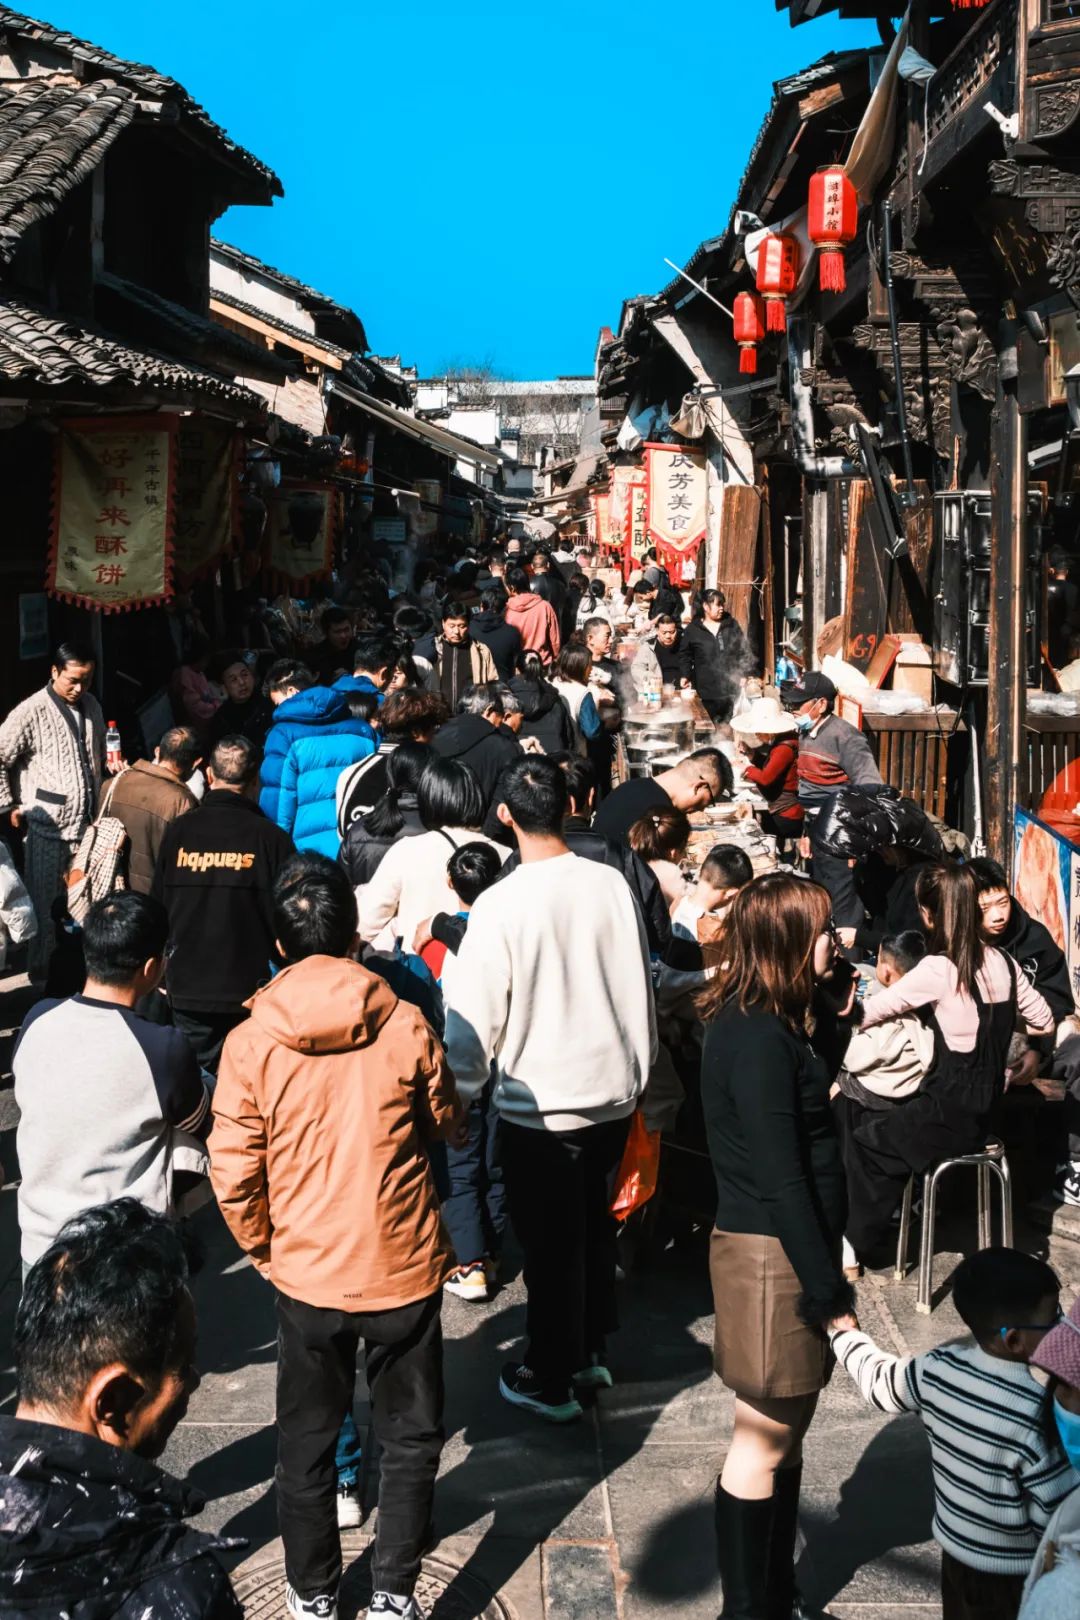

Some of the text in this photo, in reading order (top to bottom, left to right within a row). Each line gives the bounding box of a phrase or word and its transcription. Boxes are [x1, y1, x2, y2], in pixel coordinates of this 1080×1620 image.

[91, 448, 133, 586] 好再来酥饼
[667, 454, 694, 532] 庆芳美食
